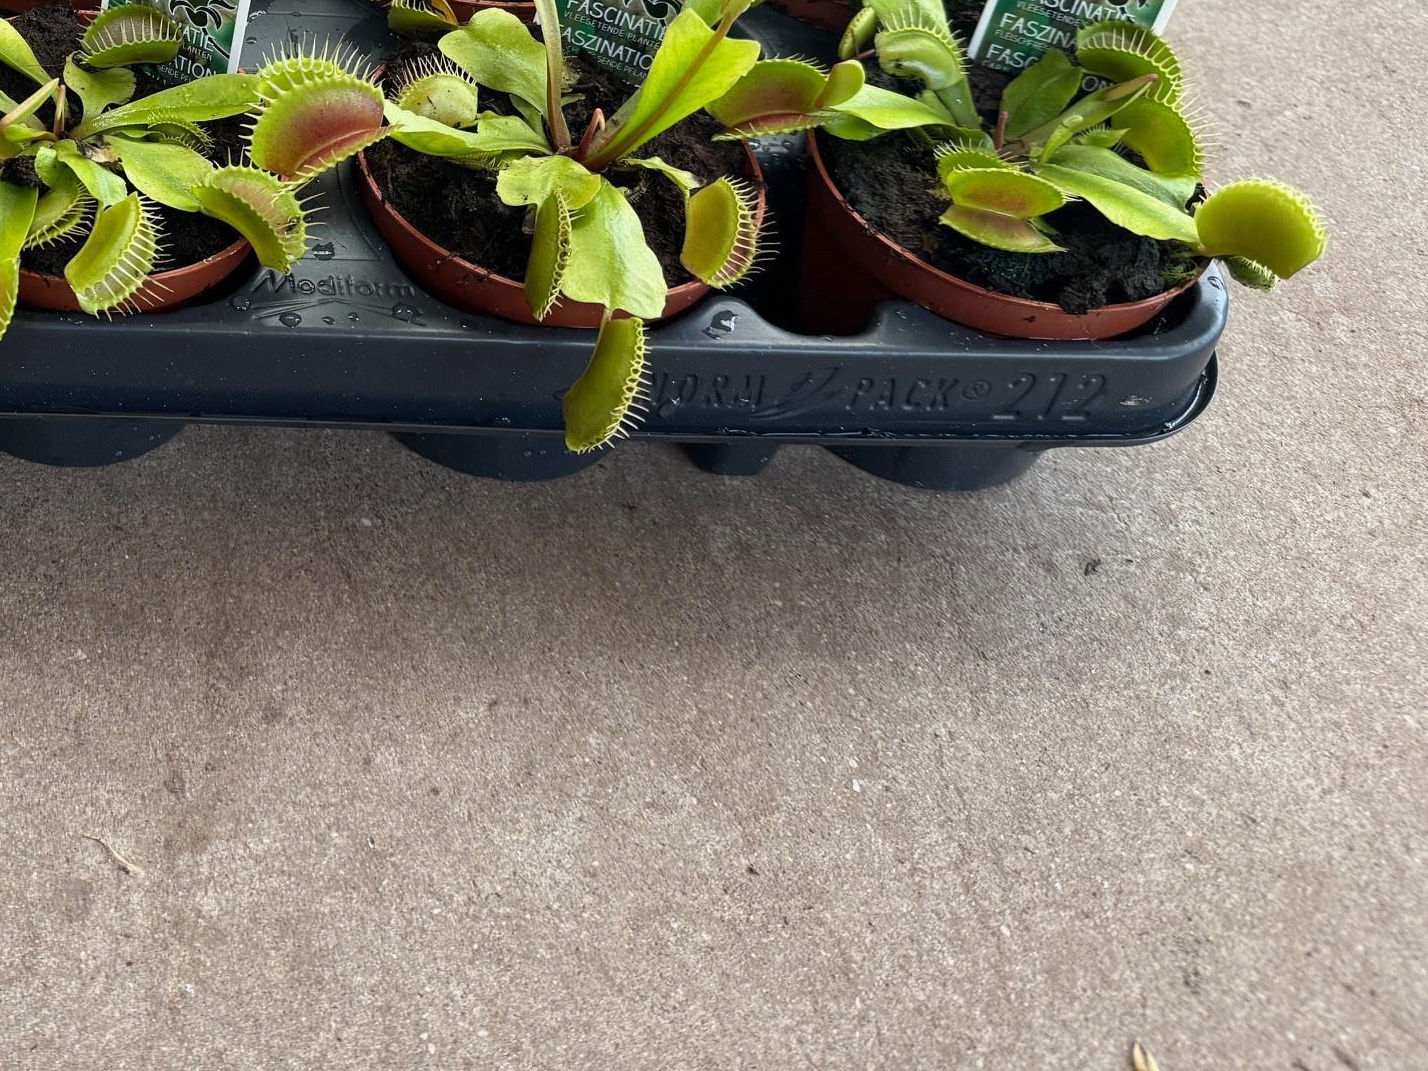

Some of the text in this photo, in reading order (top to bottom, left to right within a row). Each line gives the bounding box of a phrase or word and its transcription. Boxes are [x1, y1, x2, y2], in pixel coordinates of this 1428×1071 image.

[560, 24, 654, 71] ASZINATIO
[564, 10, 659, 49] VLEESETENDE PLANTE
[1000, 13, 1077, 48] FASZINA
[183, 44, 212, 60] LANTEN
[992, 371, 1108, 421] 212
